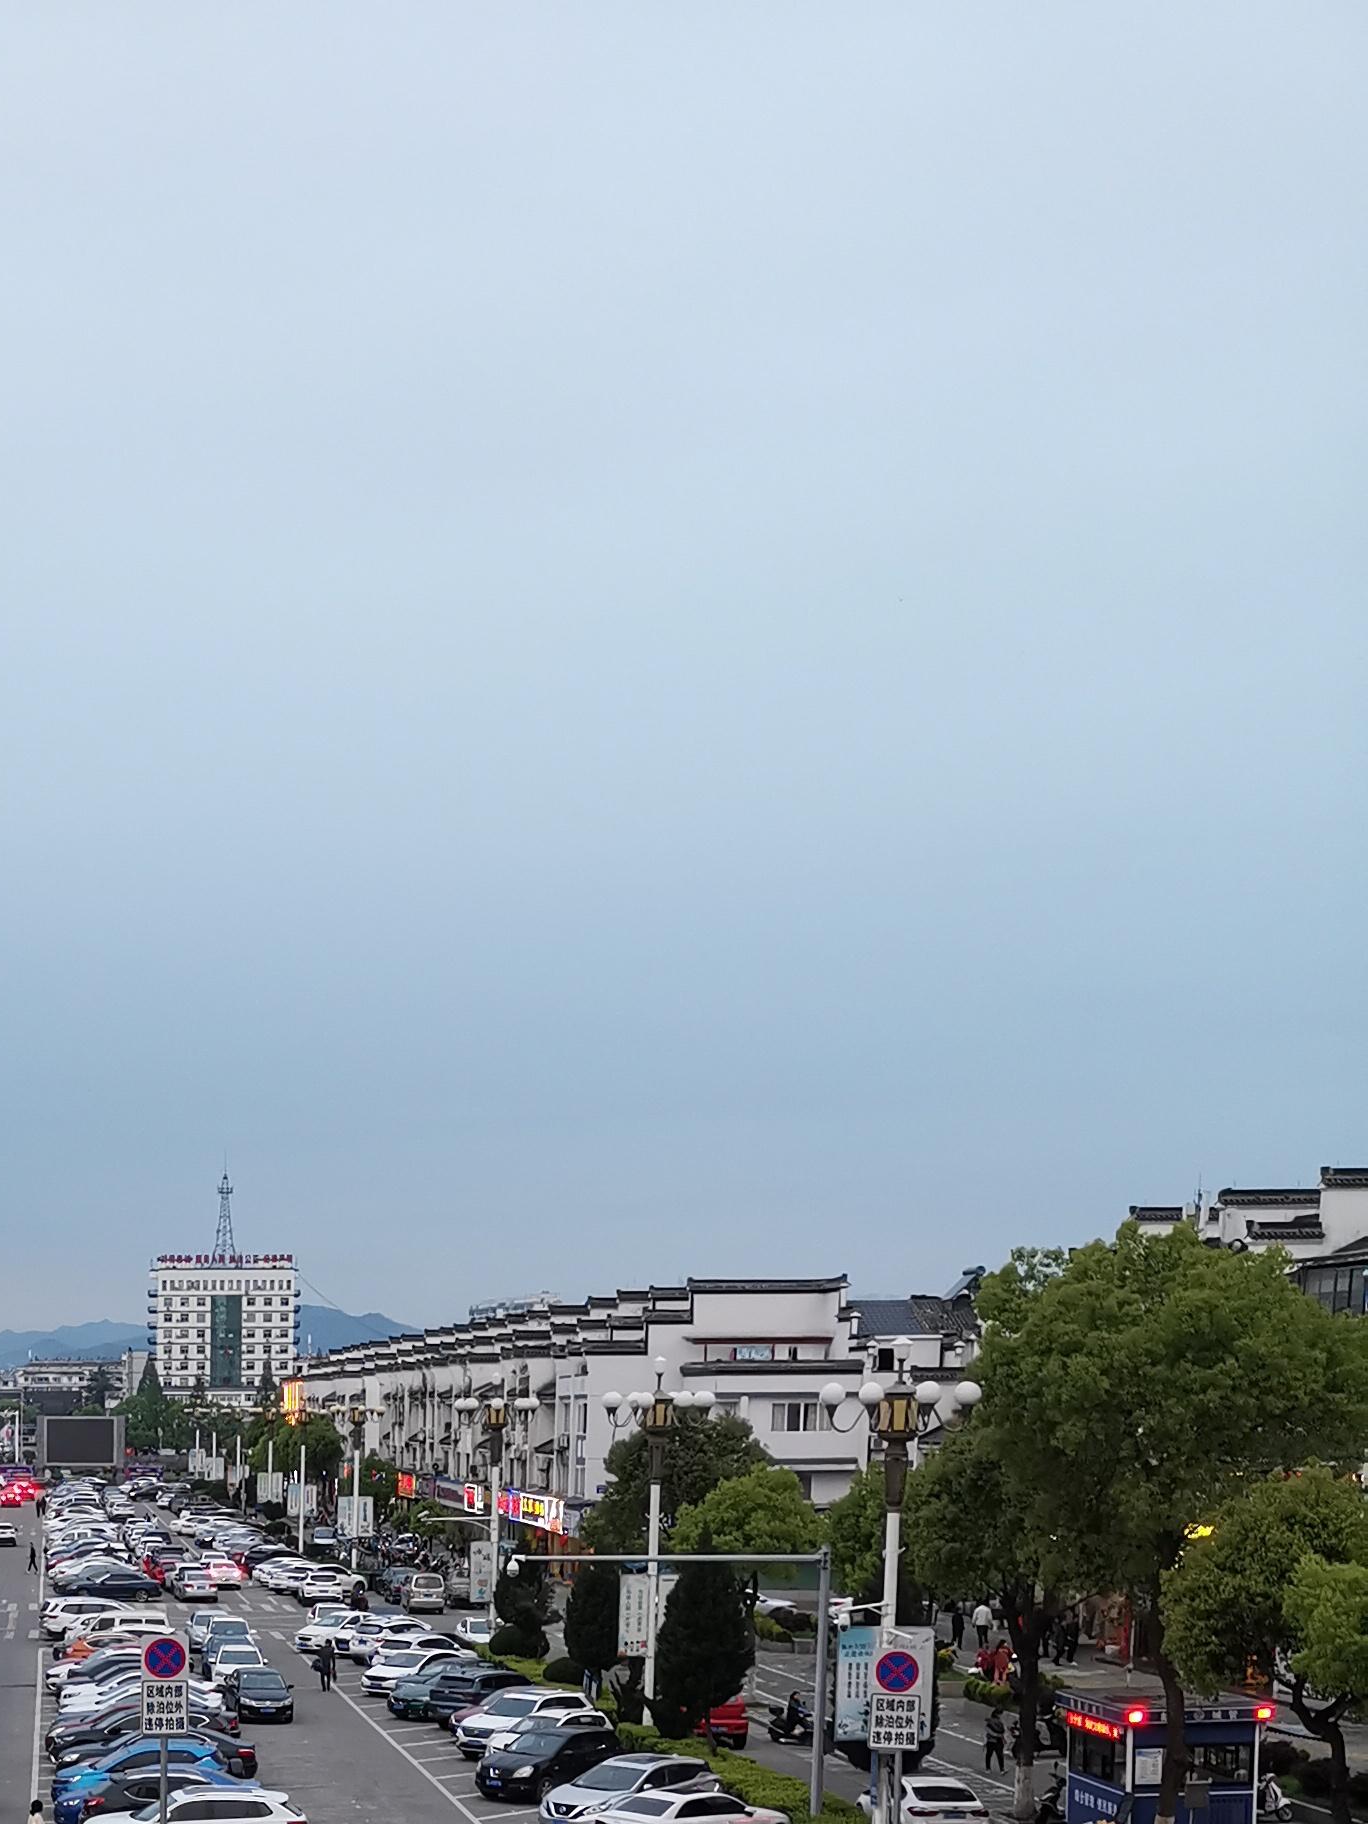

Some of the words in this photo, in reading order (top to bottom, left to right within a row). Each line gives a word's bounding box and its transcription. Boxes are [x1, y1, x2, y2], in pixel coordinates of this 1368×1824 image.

[146, 1685, 183, 1698] 区域内部
[146, 1702, 184, 1715] 除泊位外
[876, 1699, 916, 1712] 区域内部
[144, 1717, 185, 1731] 违停拍摄
[874, 1715, 914, 1729] 除泊位外
[872, 1731, 916, 1746] 违停拍摄
